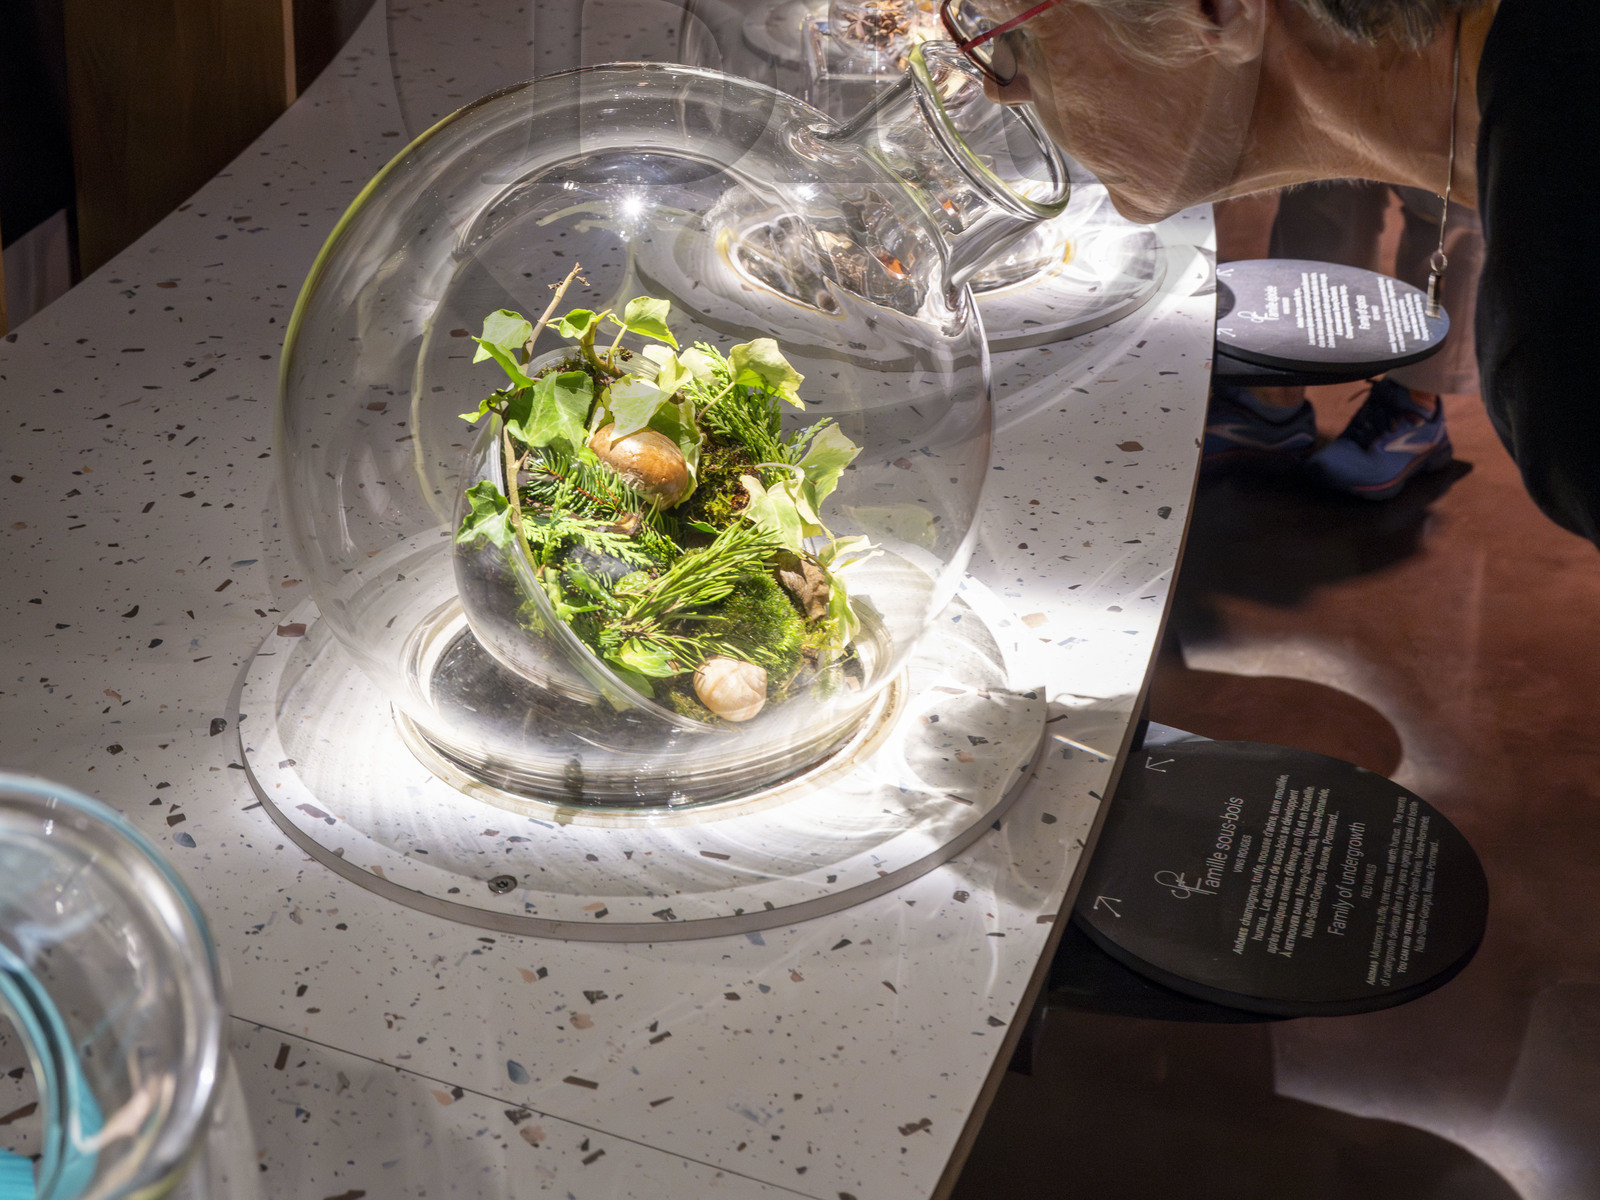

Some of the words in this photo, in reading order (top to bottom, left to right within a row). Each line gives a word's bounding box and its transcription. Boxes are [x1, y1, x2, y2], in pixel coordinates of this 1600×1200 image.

[1190, 852, 1228, 895] Famille
[1216, 797, 1244, 850] sous-bois
[1237, 834, 1252, 858] ROUGES
[1340, 822, 1366, 885] undergrowth
[1233, 858, 1246, 872] VINS
[1364, 864, 1377, 884] WINES
[1335, 885, 1352, 898] of
[1360, 885, 1373, 899] RED
[1327, 899, 1354, 936] Family
